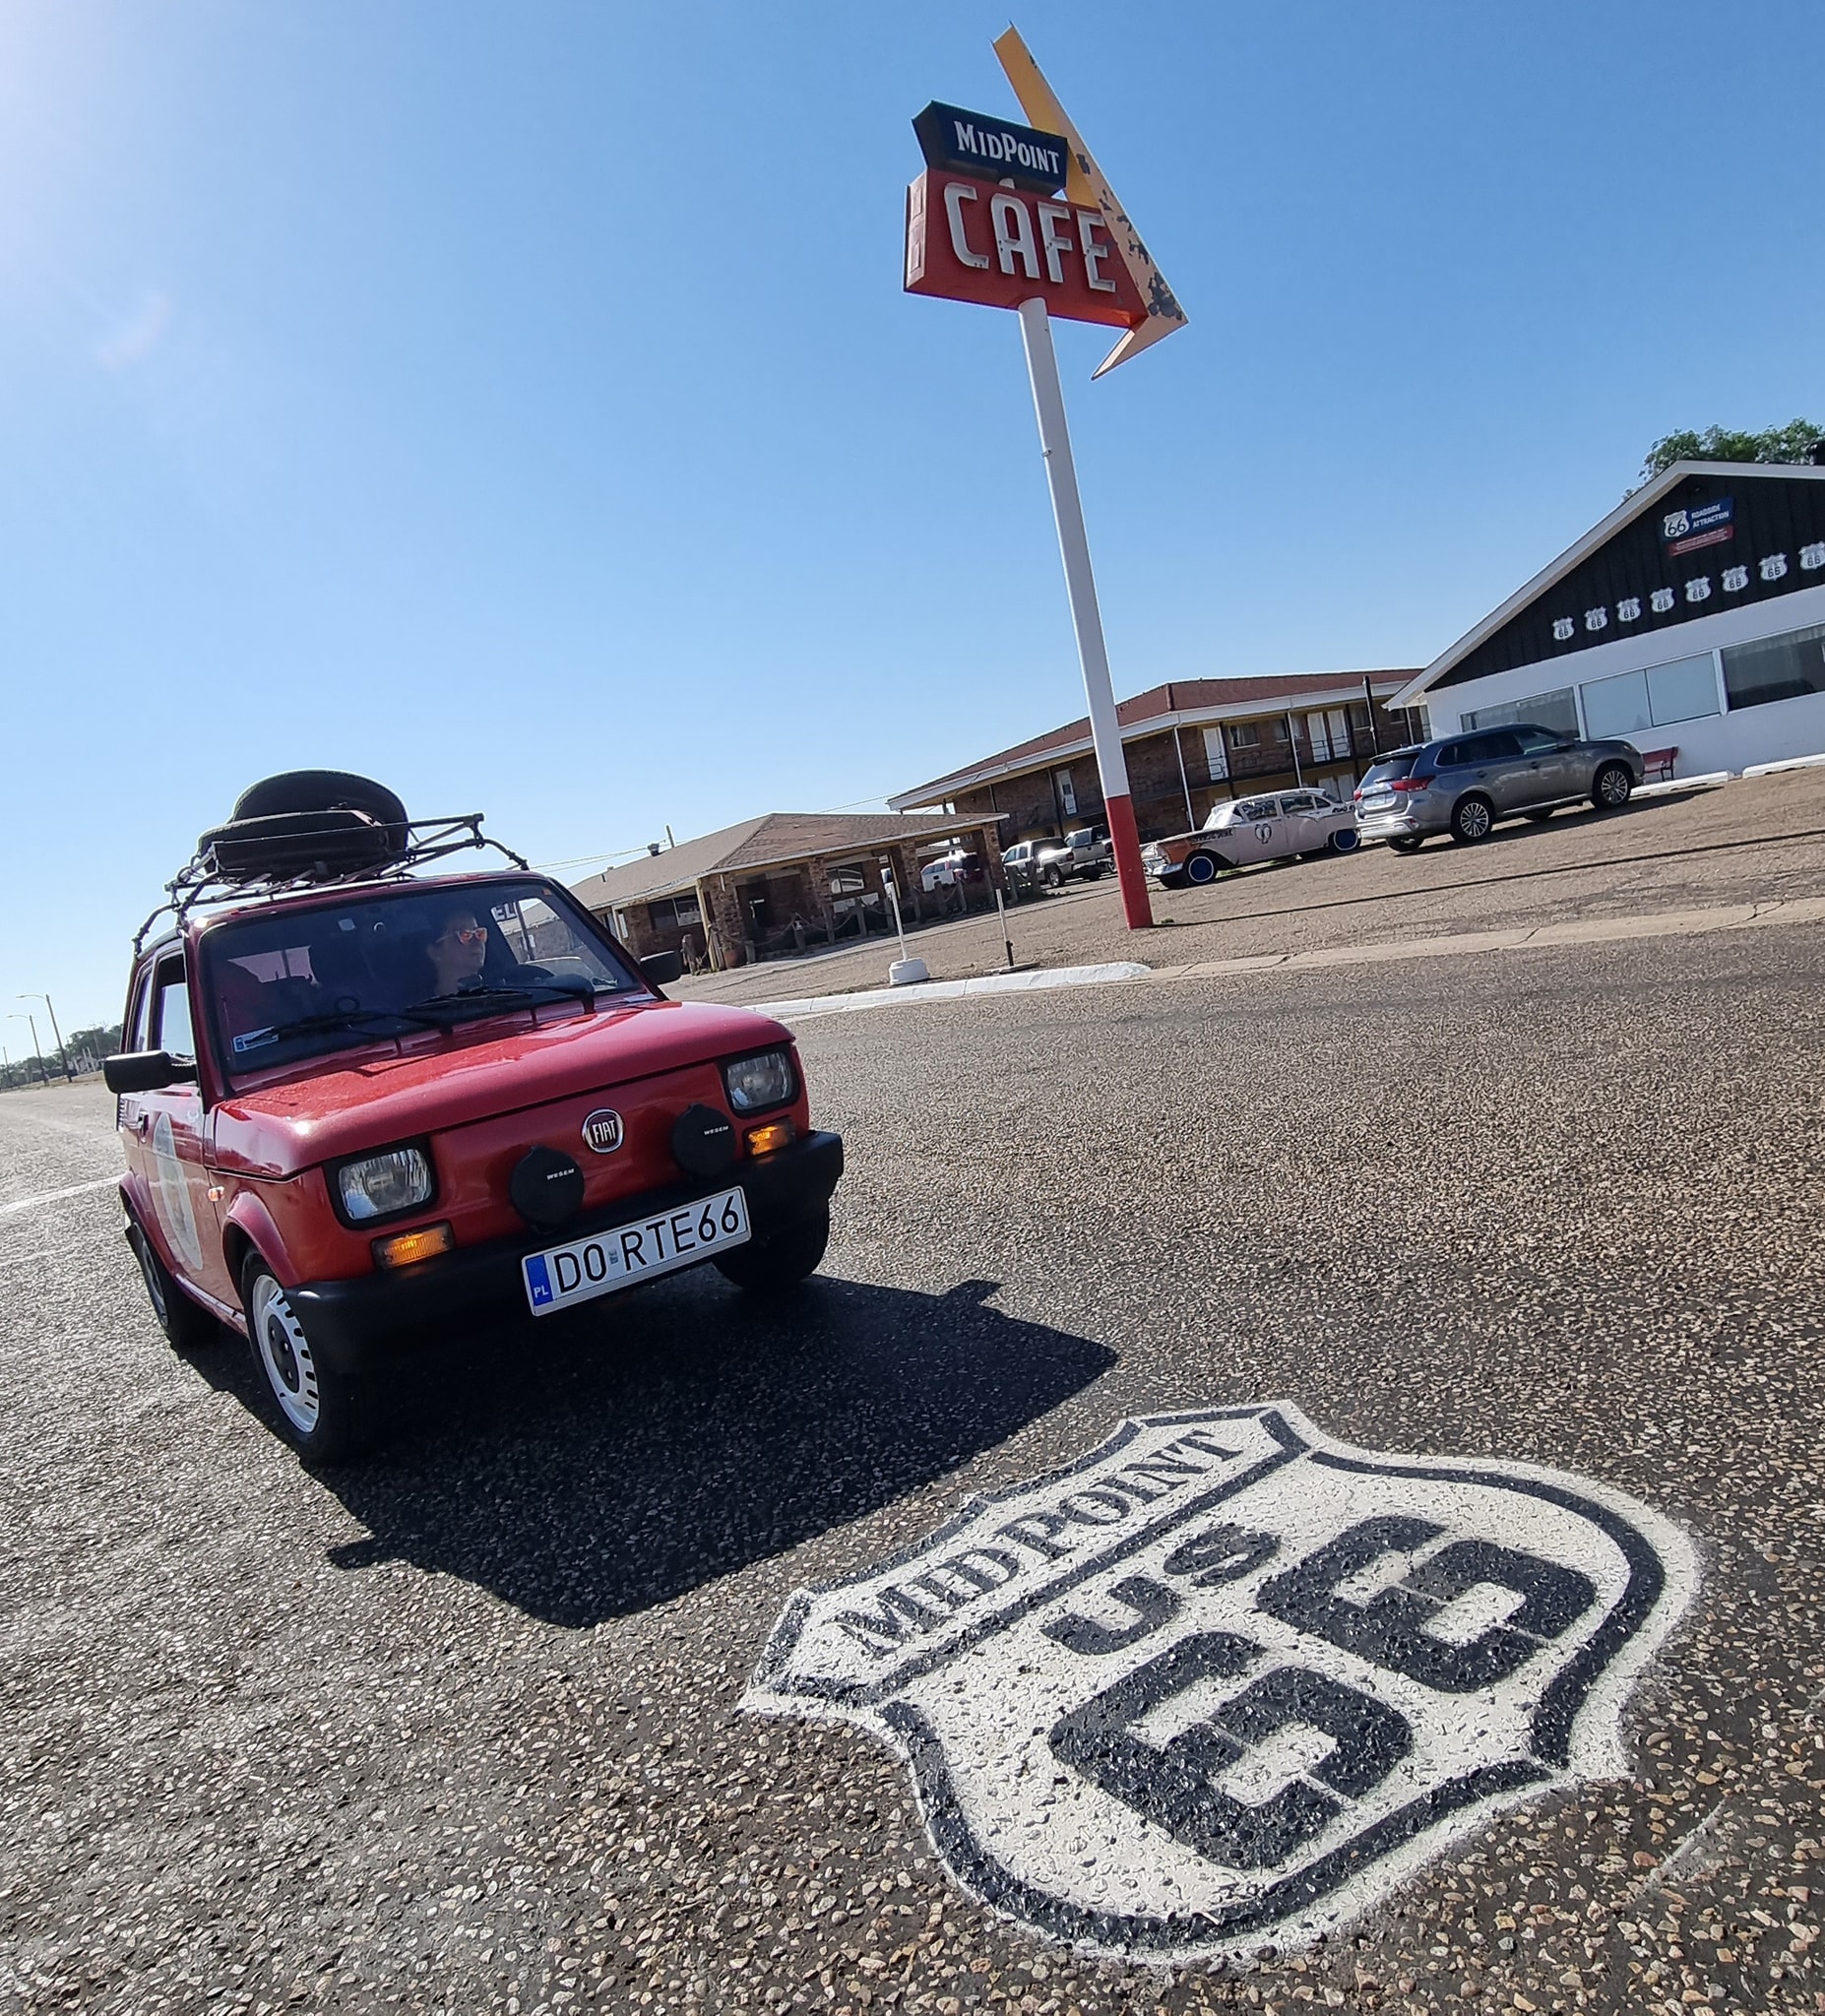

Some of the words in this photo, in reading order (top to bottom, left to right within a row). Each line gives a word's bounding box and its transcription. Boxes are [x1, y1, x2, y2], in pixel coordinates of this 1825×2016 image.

[953, 120, 1060, 175] MIDPOINT
[943, 181, 1117, 293] CAFE
[1668, 518, 1686, 536] 66
[1692, 510, 1730, 529] ATTRACTION
[592, 1119, 617, 1144] FIAT
[703, 1124, 729, 1137] WESEM
[546, 1167, 575, 1181] WESEM
[619, 1194, 739, 1272] RTE66
[533, 1286, 549, 1298] PL
[820, 1428, 1244, 1661] MIDPOINT
[1039, 1522, 1283, 1656] US
[1046, 1513, 1598, 1870] 66
